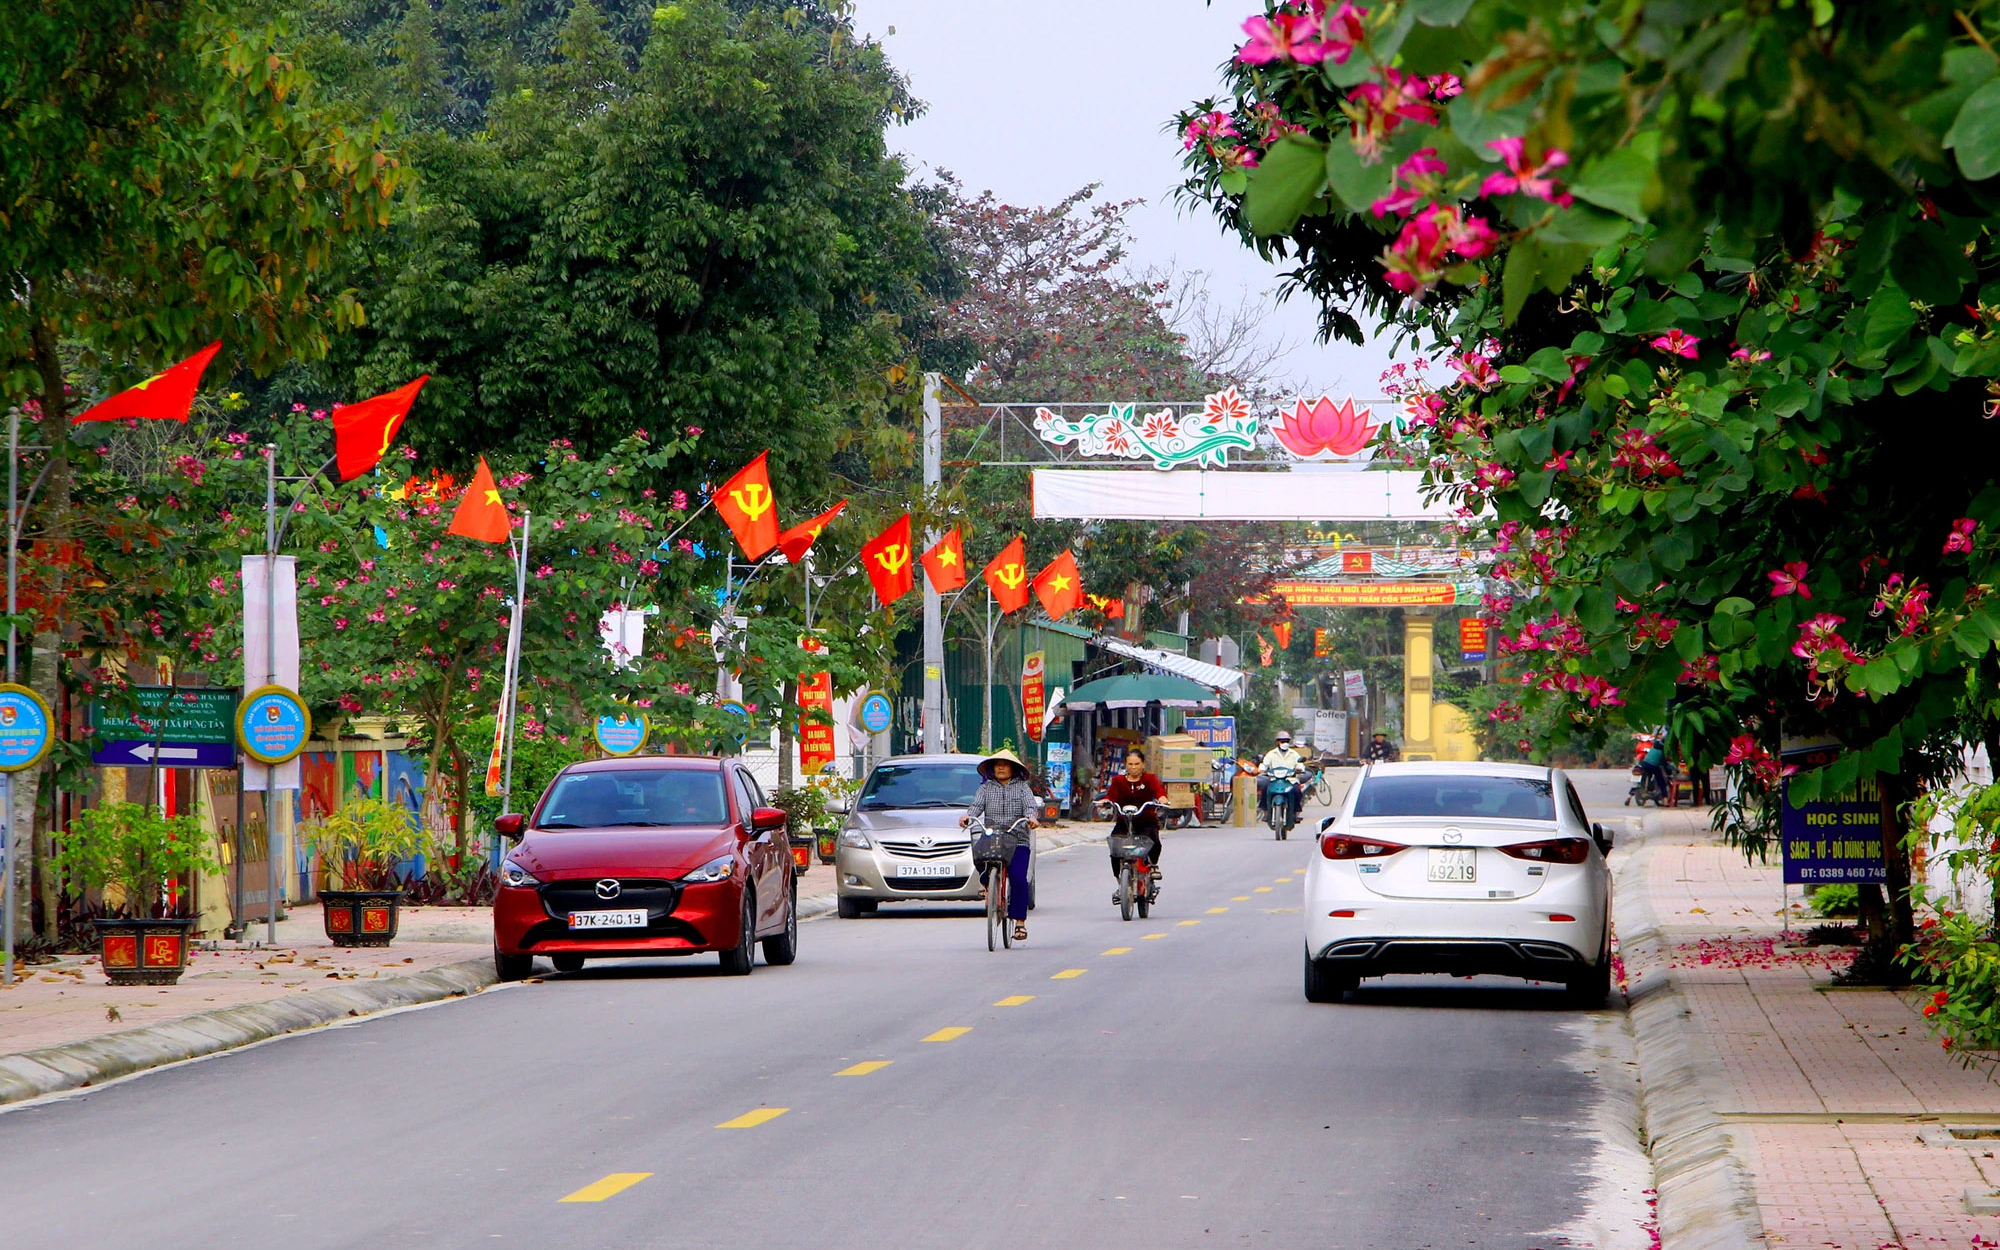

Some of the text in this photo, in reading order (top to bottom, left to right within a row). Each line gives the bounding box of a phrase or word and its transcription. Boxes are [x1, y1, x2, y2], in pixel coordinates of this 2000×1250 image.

[1430, 585, 1446, 593] CAO
[1316, 710, 1346, 719] Coffee
[1806, 812, 1880, 828] HỌC SINH
[1790, 836, 1810, 859] SÁCH
[1816, 833, 1827, 859] VỞ
[1832, 835, 1843, 859] ĐỒ
[1844, 836, 1865, 859] DÙNG
[1866, 841, 1882, 863] HỌC
[1439, 851, 1465, 864] 37A
[1429, 865, 1475, 880] 492.19
[1800, 867, 1887, 878] ĐT: 0389 460 748
[576, 914, 641, 927] 37K-240.19
